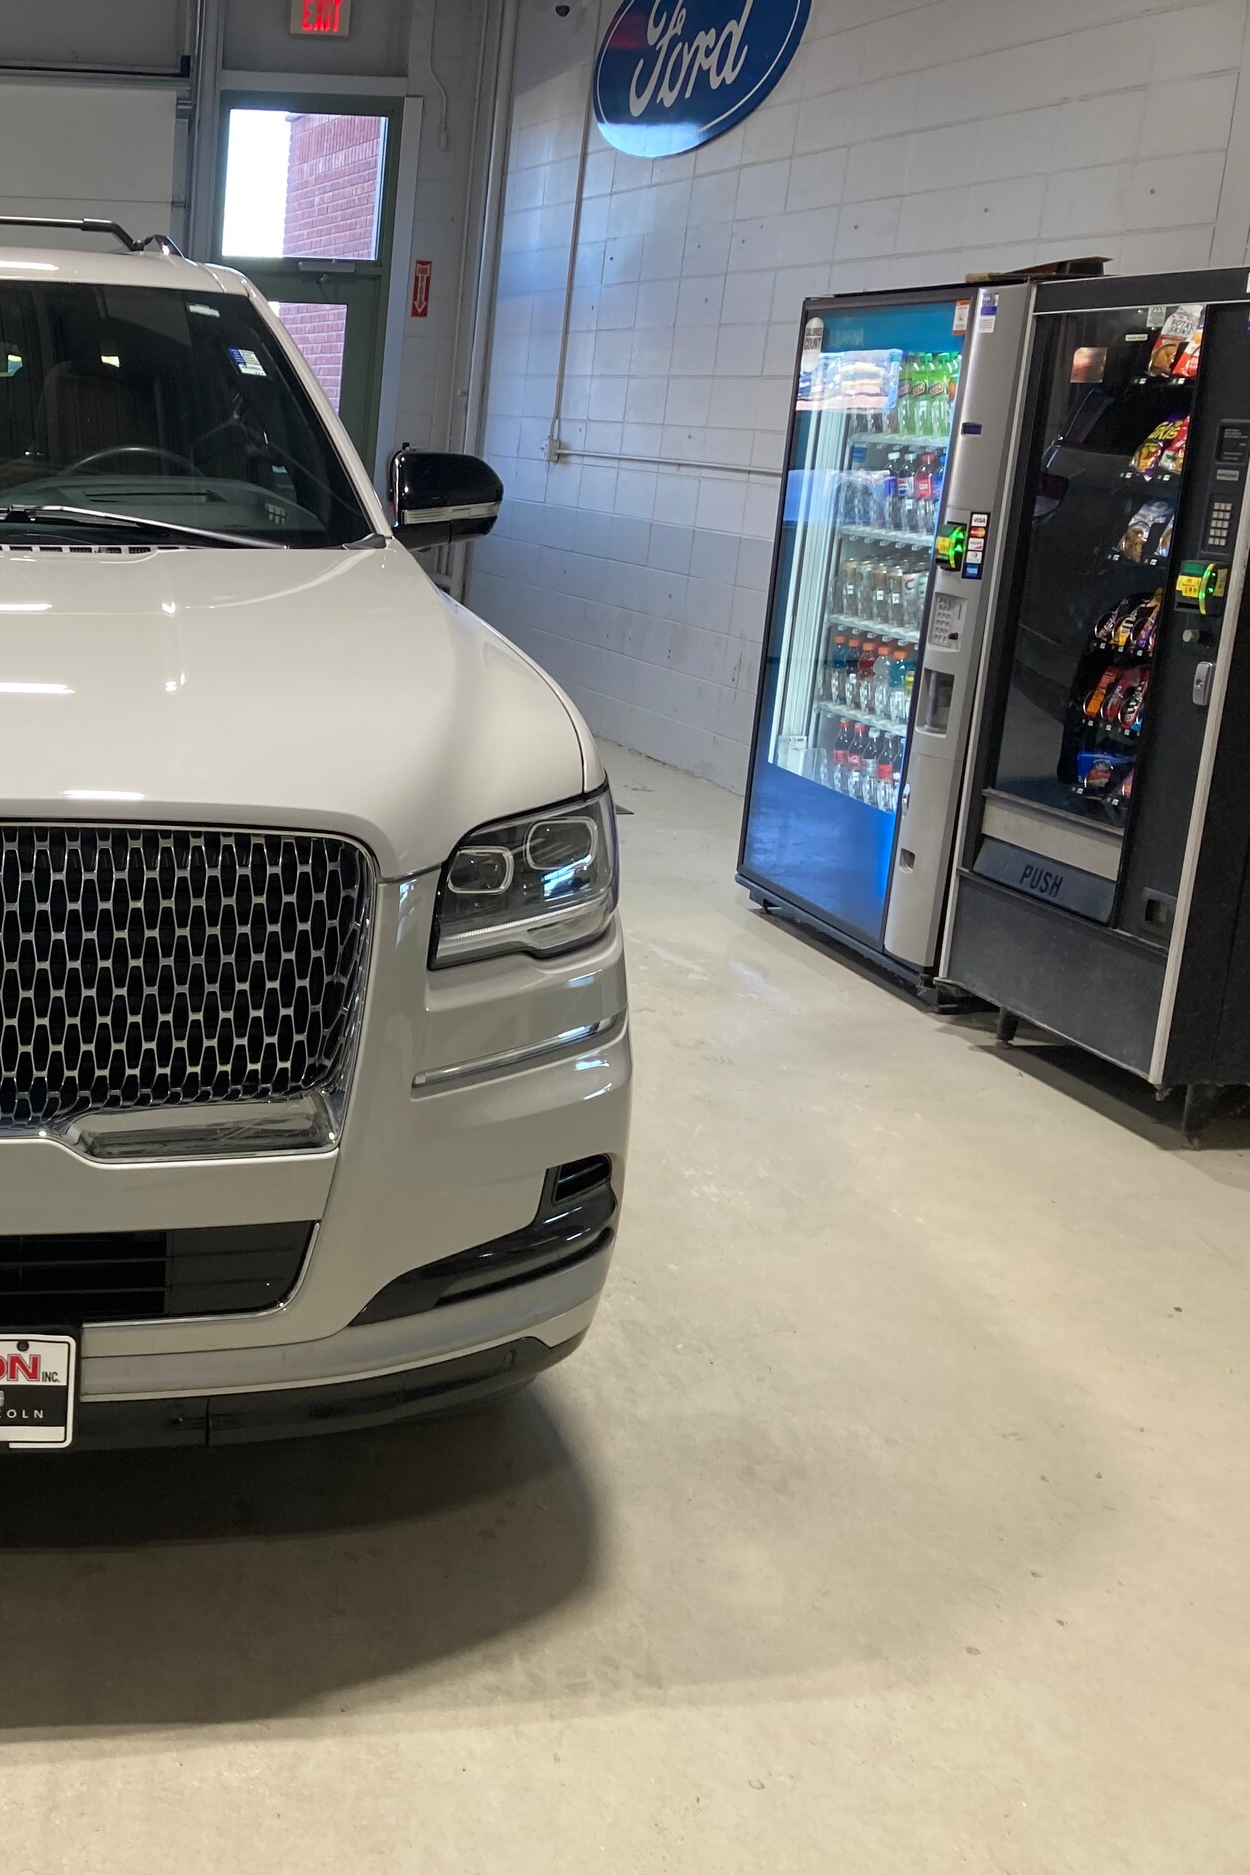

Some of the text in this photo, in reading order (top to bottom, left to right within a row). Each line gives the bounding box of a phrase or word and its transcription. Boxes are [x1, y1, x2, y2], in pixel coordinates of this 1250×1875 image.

[629, 0, 752, 117] Ford
[804, 337, 821, 349] COUNT
[1020, 864, 1063, 898] PUSH
[42, 1371, 60, 1383] INC.
